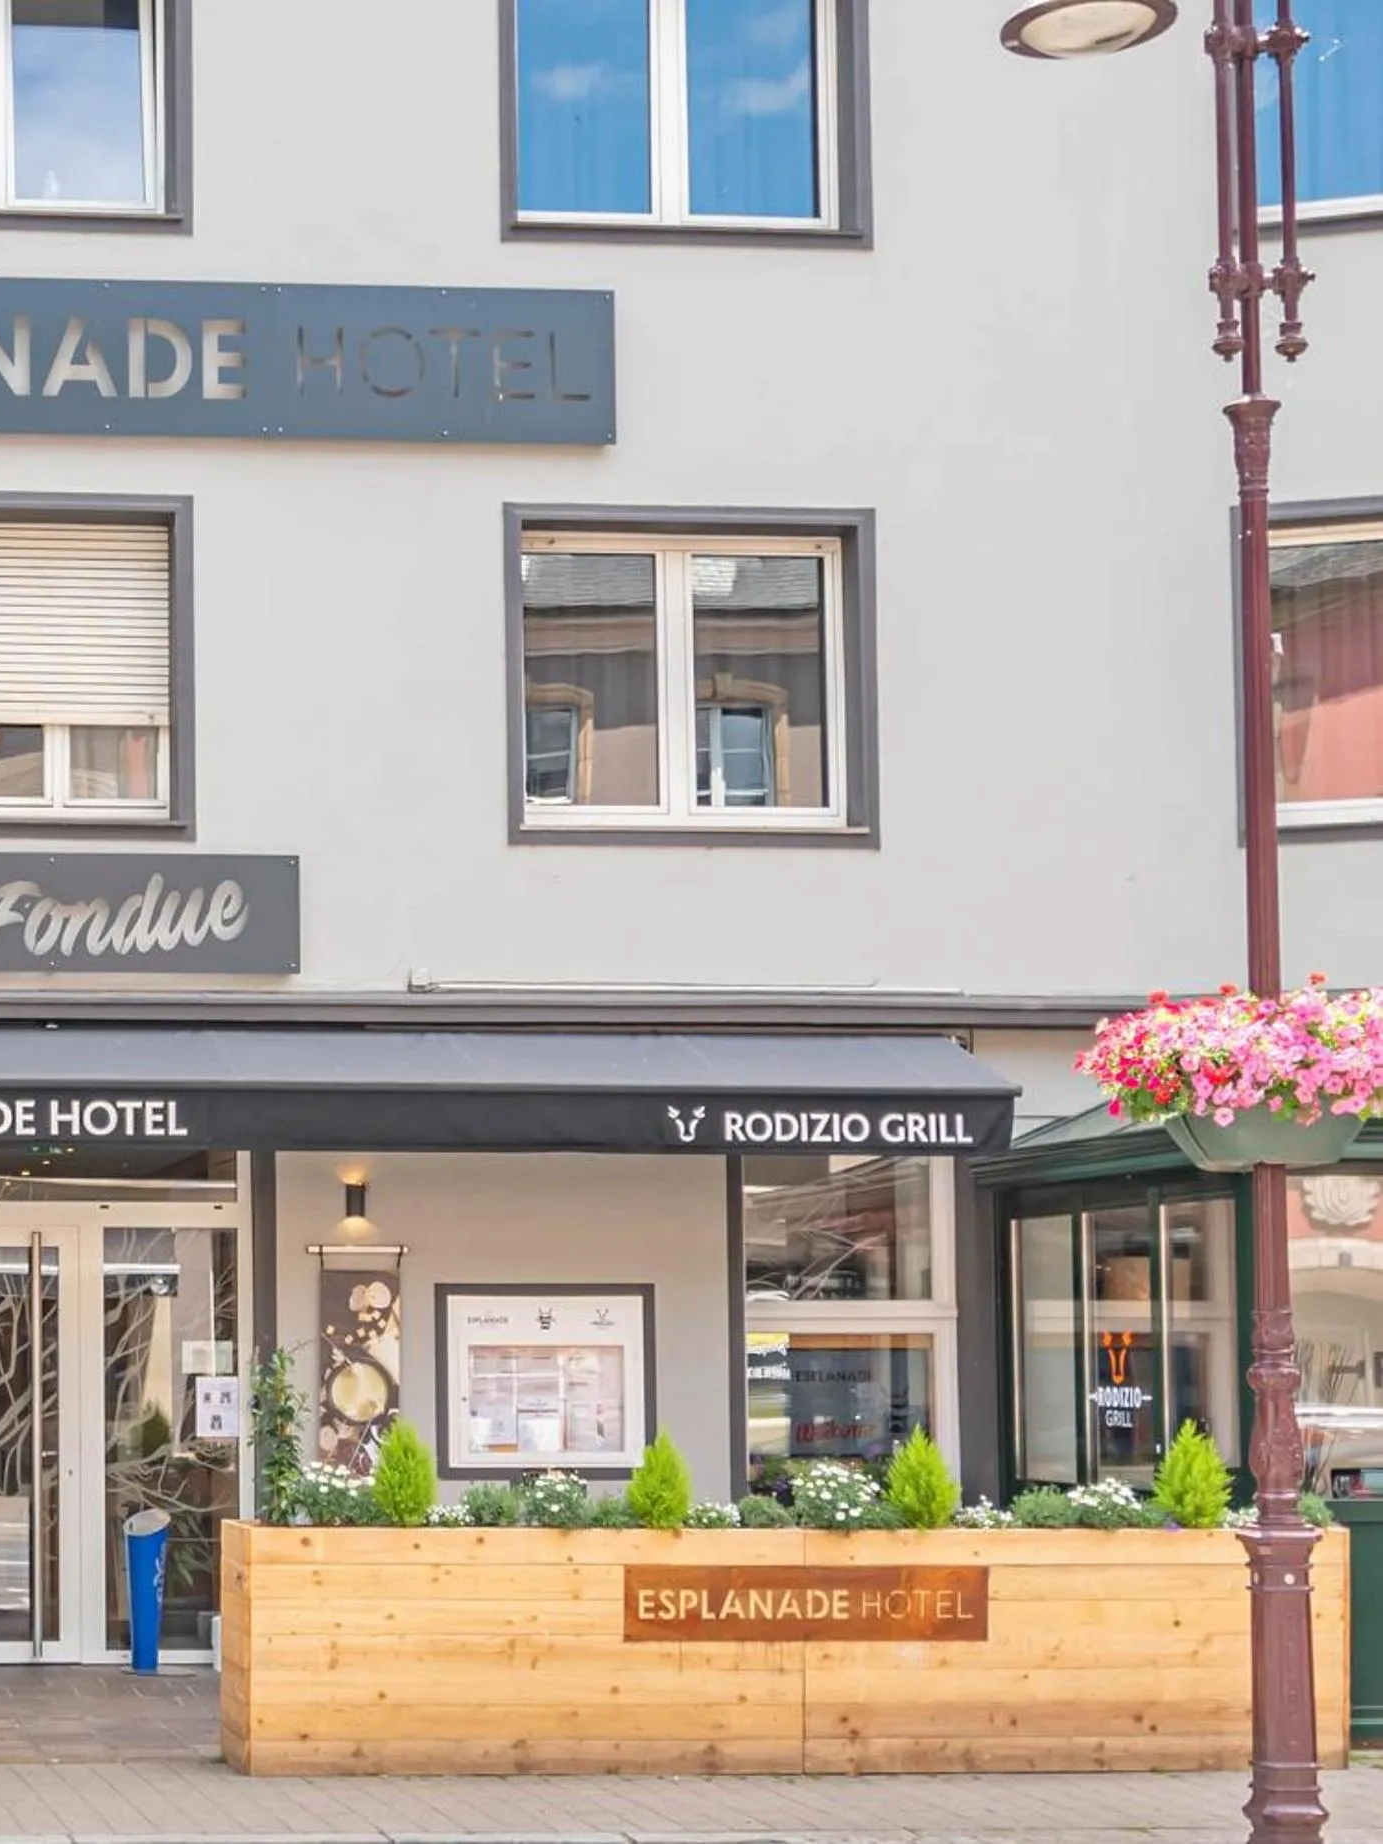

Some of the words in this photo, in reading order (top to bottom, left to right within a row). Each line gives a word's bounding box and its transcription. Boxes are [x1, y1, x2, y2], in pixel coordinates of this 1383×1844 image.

[295, 325, 590, 400] HOTEL
[49, 1101, 188, 1136] HOTEL
[724, 1111, 869, 1142] RODIZIO
[879, 1113, 973, 1143] GRILL
[1097, 1386, 1142, 1408] RODIZIO
[1105, 1410, 1133, 1427] GRILL
[637, 1588, 849, 1620] ESPLANADE
[861, 1590, 974, 1619] HOTEL
